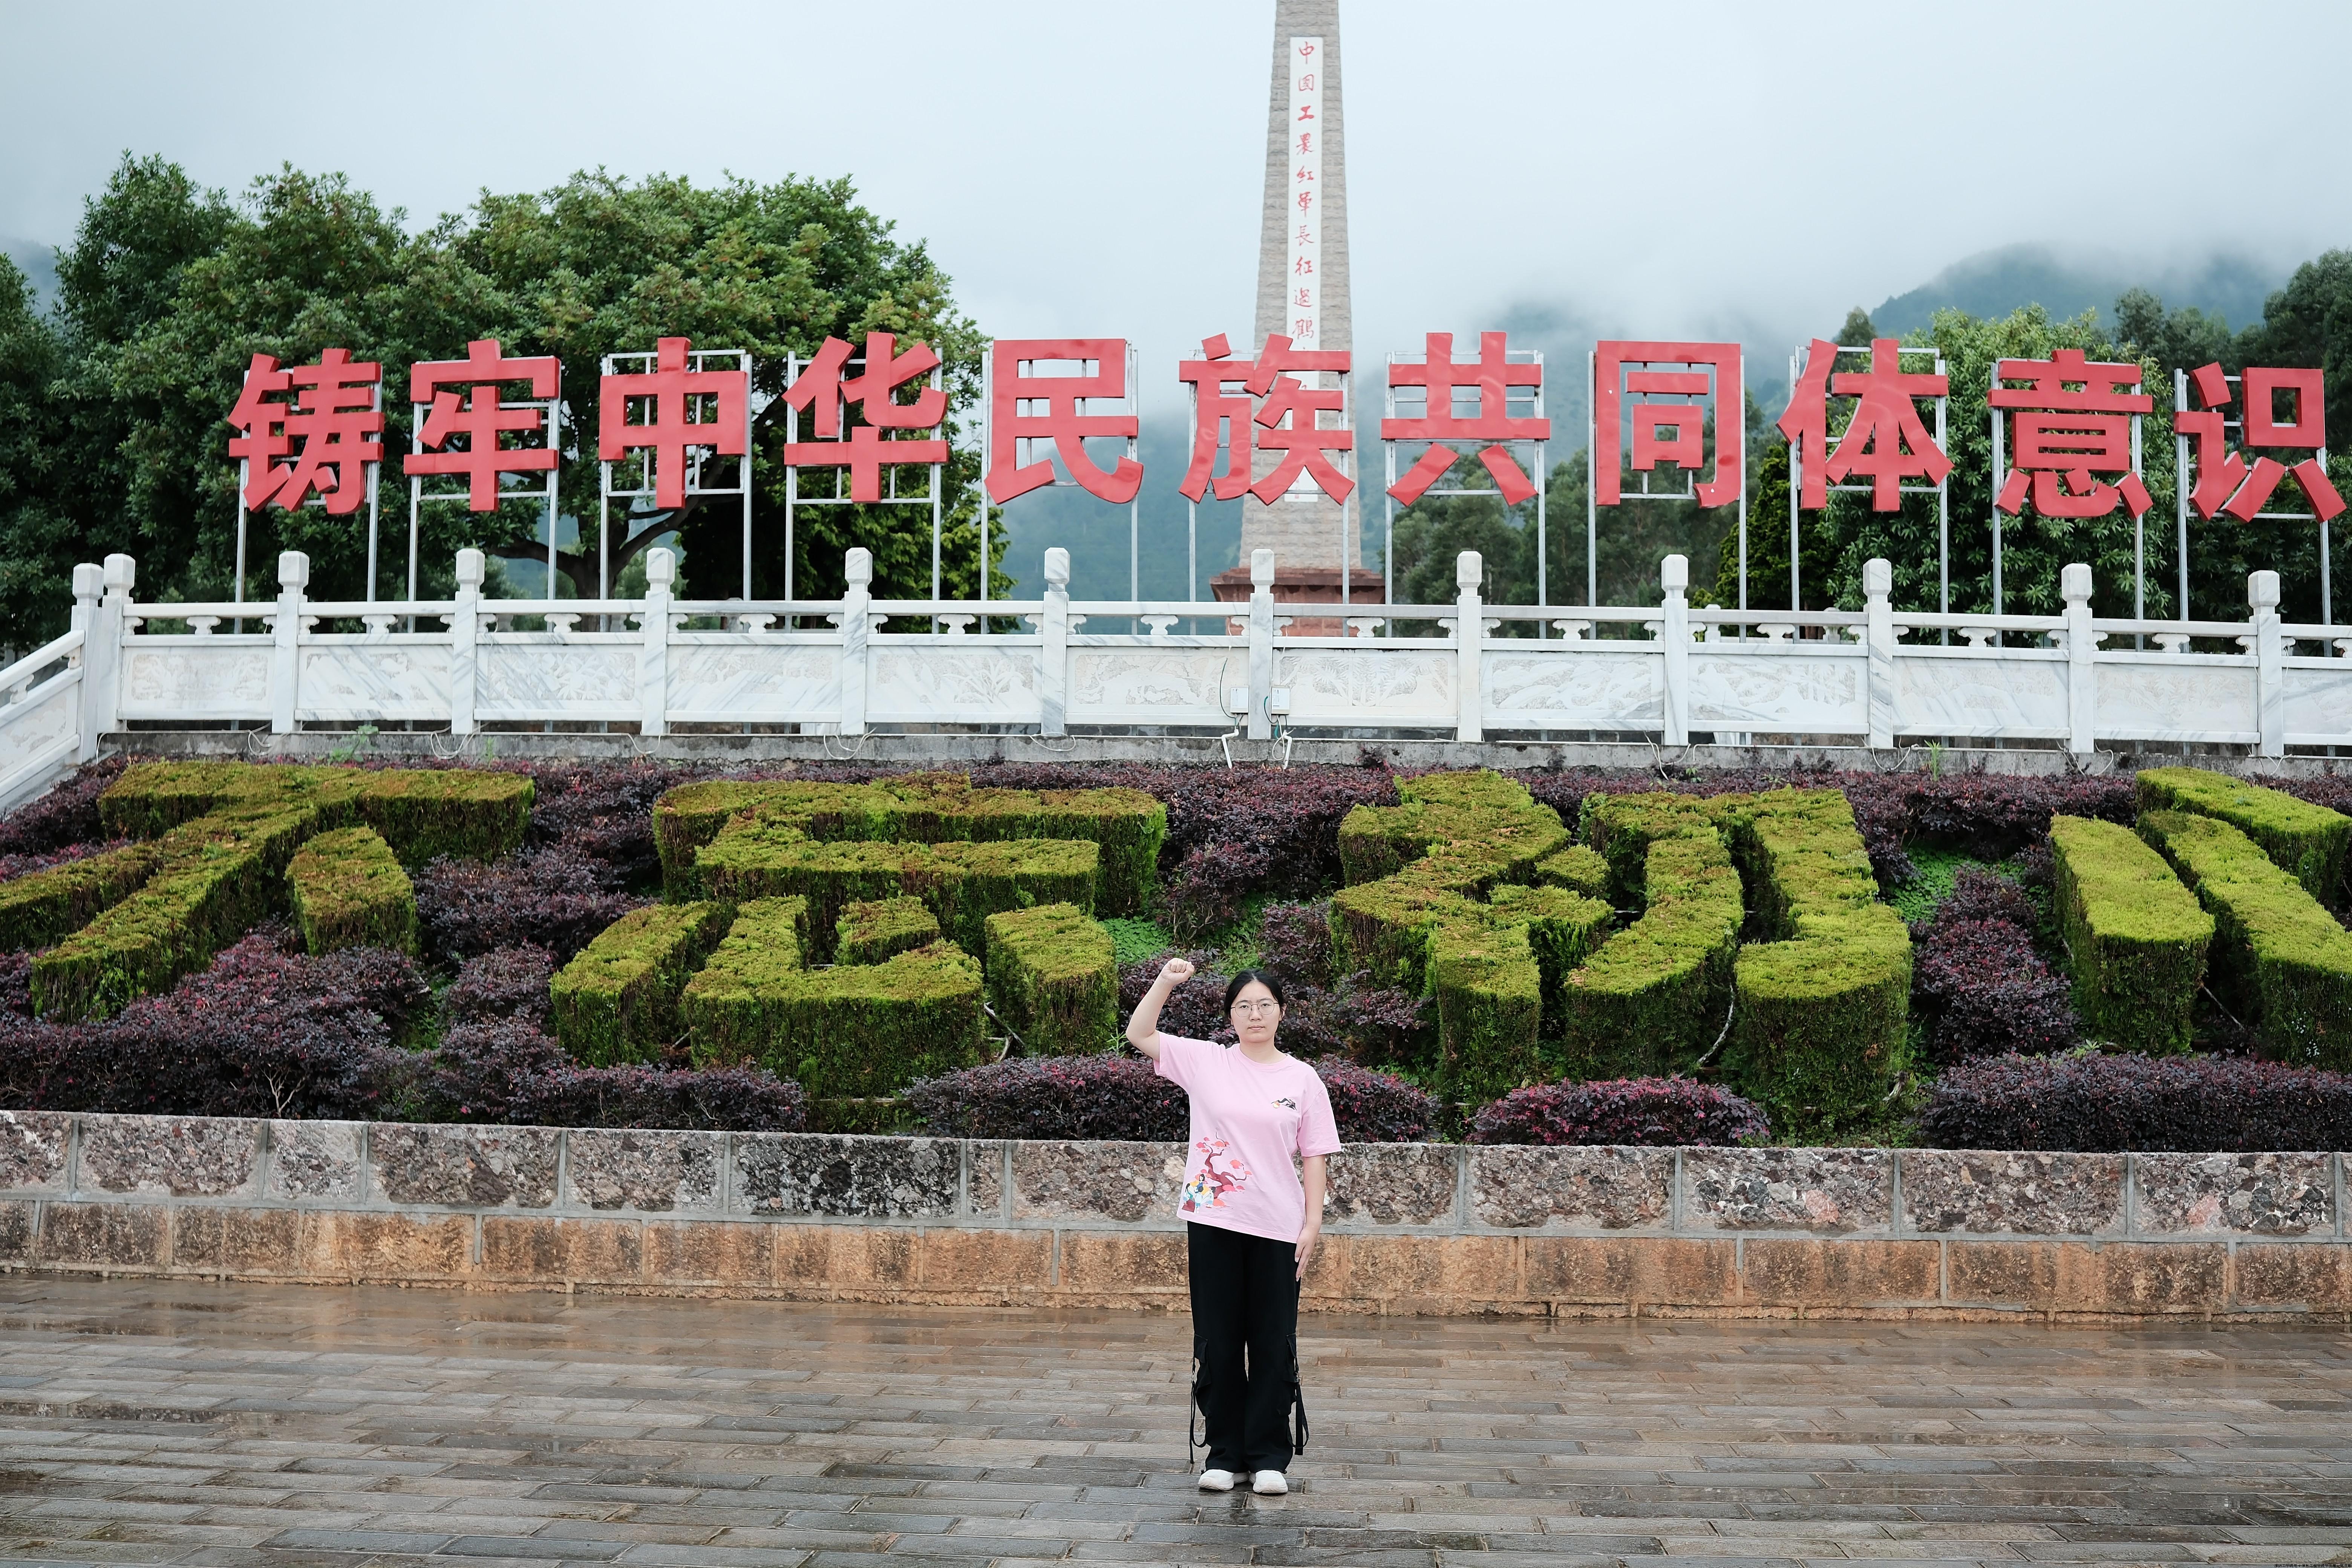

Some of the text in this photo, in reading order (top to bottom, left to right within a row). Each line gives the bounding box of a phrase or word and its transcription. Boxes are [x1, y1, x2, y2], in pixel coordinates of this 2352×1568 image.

[227, 332, 2347, 523] 铸牢中华民族共同体意识
